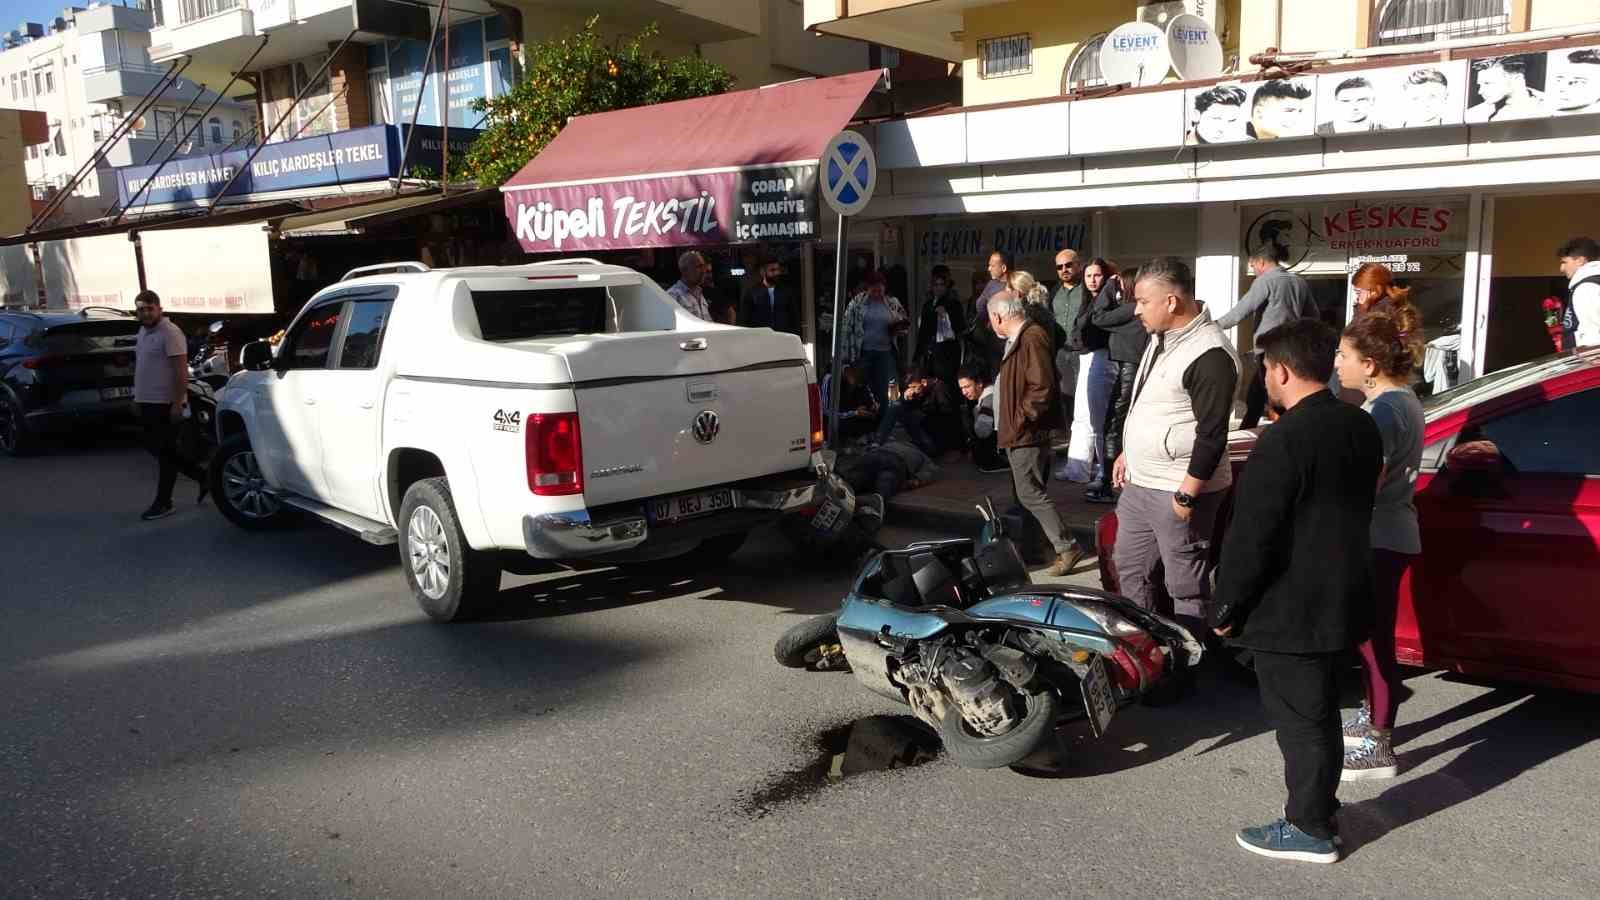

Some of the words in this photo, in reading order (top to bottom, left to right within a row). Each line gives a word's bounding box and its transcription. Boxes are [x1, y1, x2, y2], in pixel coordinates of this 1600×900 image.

[1113, 36, 1159, 48] LEVENT
[1172, 28, 1208, 41] LEVENT
[421, 137, 445, 152] KILI
[254, 161, 280, 178] KILIÇ
[280, 149, 344, 174] KARDEŞLER
[346, 143, 383, 163] TEKEL
[751, 178, 794, 196] ÇORAP
[742, 196, 805, 215] TUHAFİYE
[516, 195, 606, 248] Küpeli
[610, 190, 720, 240] TEKSTİL
[1324, 204, 1452, 237] KESKES
[736, 220, 750, 240] İÇ
[751, 221, 814, 240] ÇAMAŞIRI
[1330, 239, 1371, 250] ERKEK
